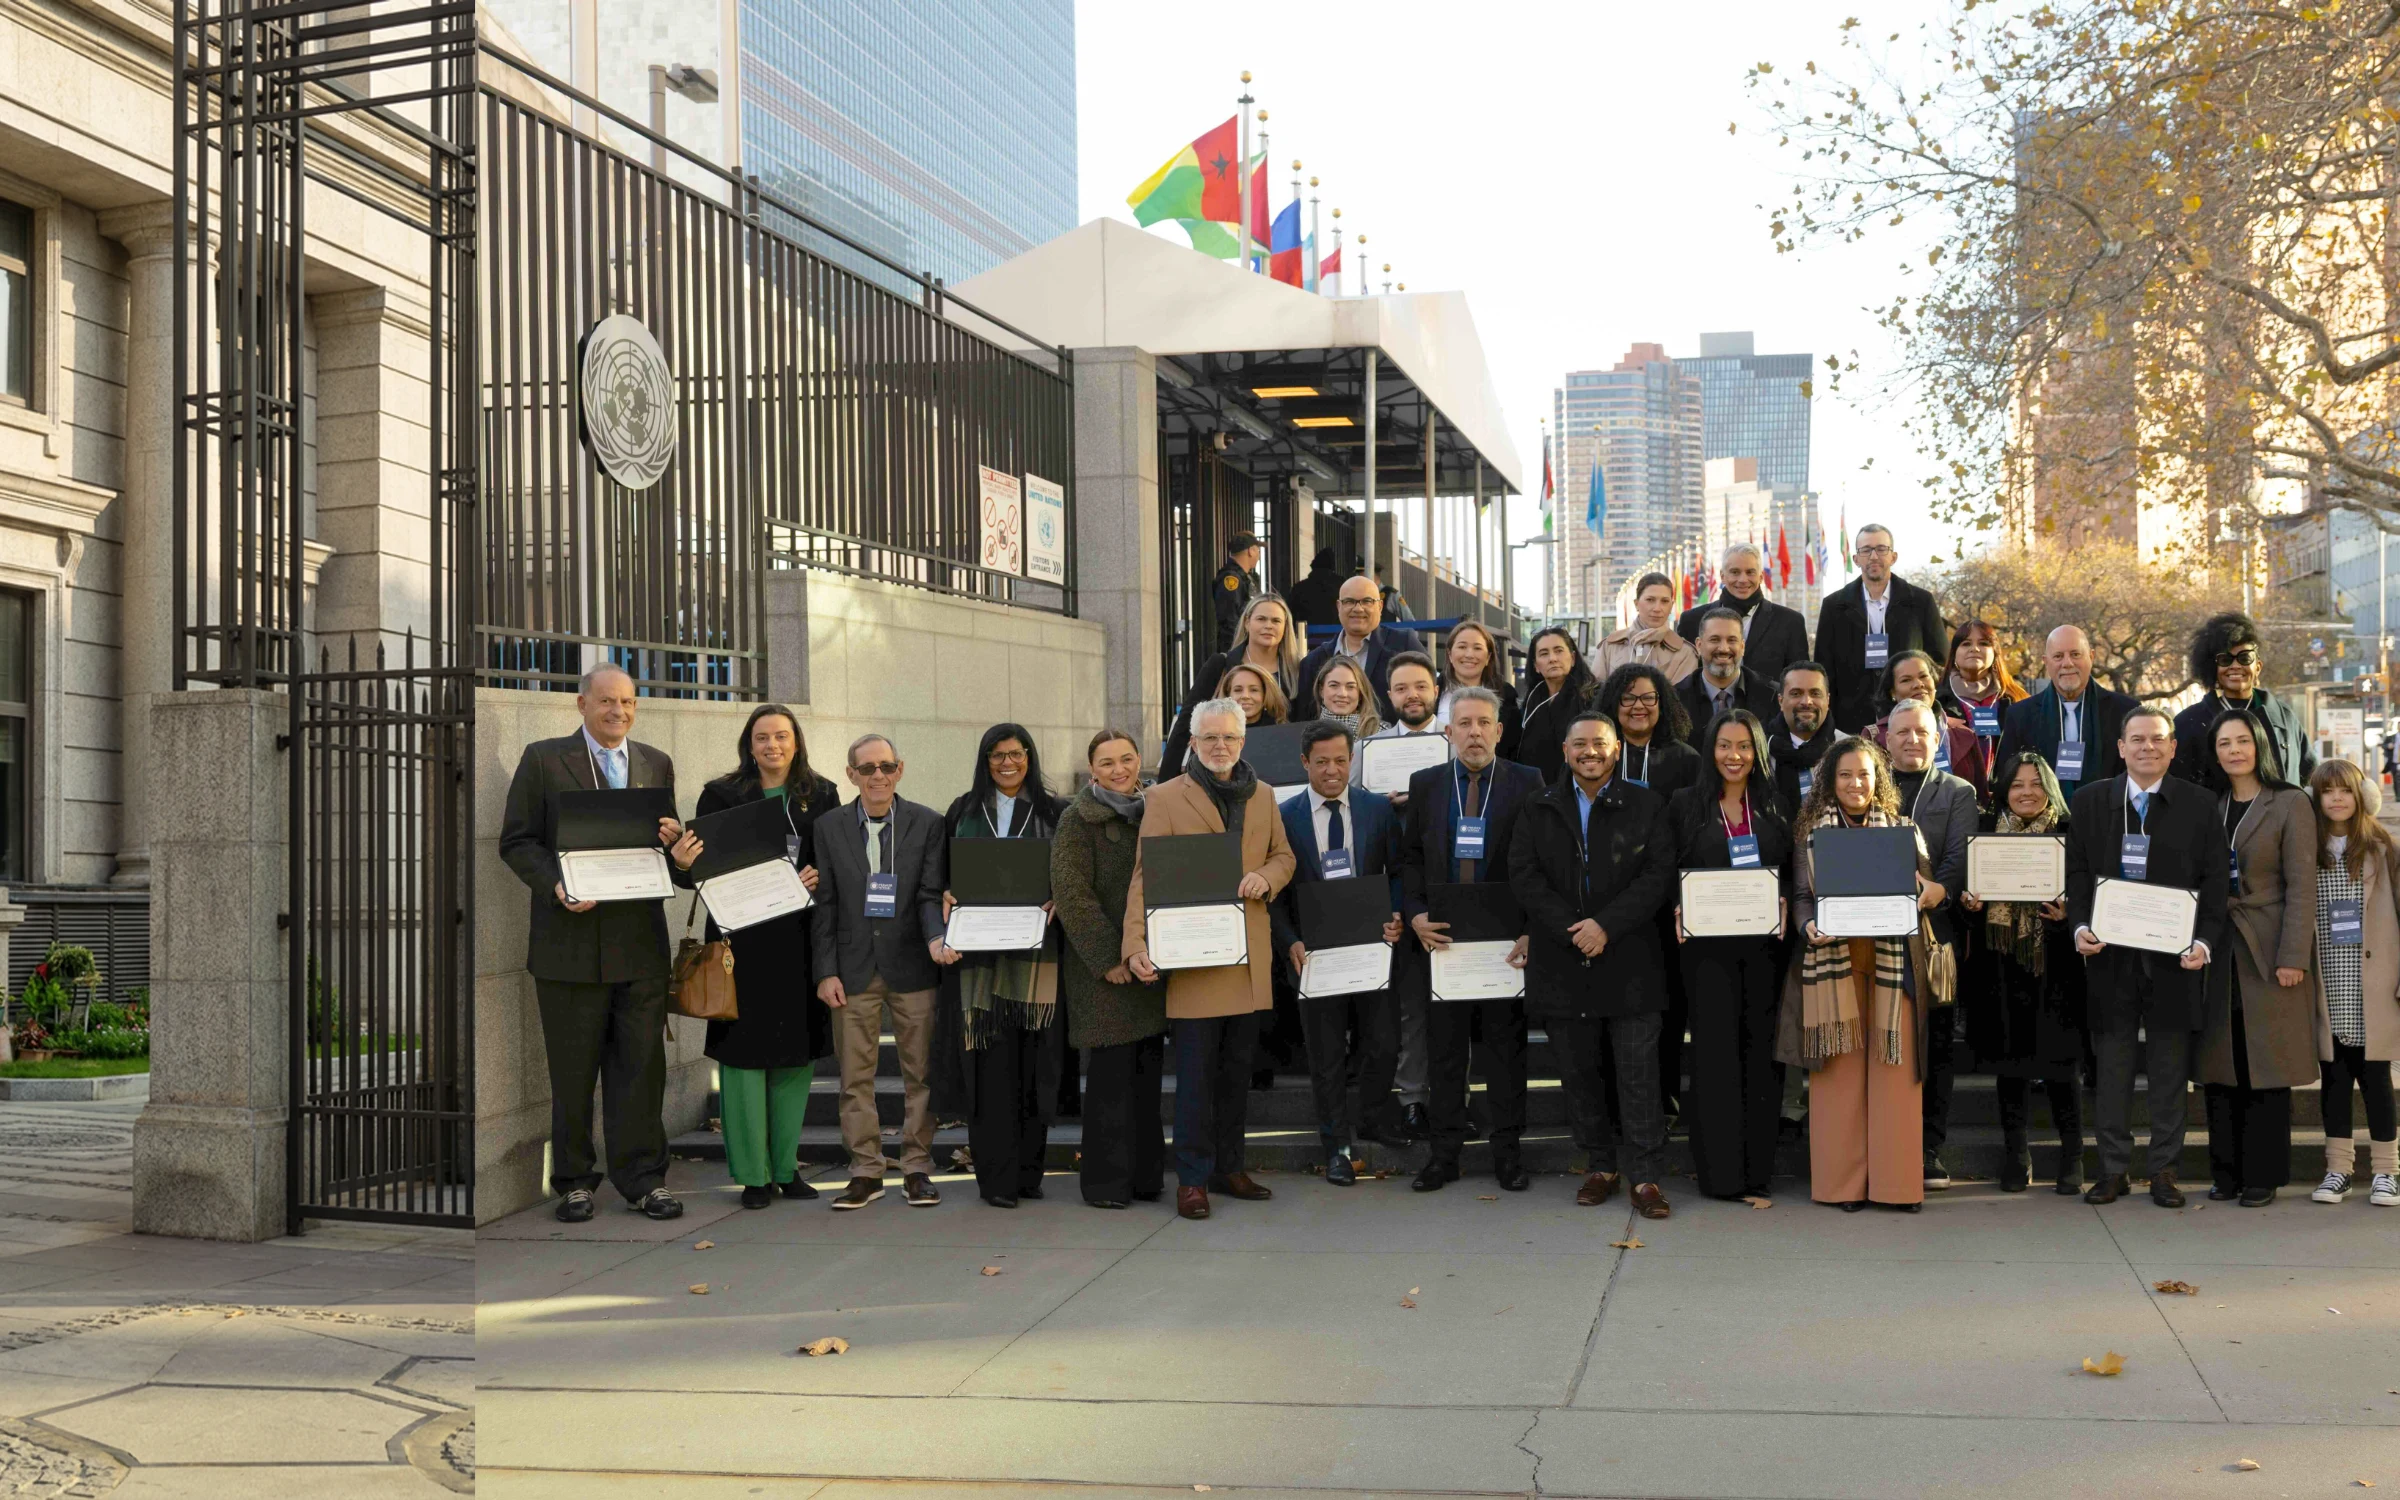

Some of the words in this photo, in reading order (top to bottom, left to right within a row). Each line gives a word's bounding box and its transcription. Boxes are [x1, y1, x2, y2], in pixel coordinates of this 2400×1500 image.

[1030, 482, 1047, 494] WELCOME
[1028, 490, 1043, 502] UNITED
[1045, 495, 1062, 508] NATIONS
[1032, 556, 1050, 565] VISITORS
[1031, 563, 1051, 573] ENTRANCE
